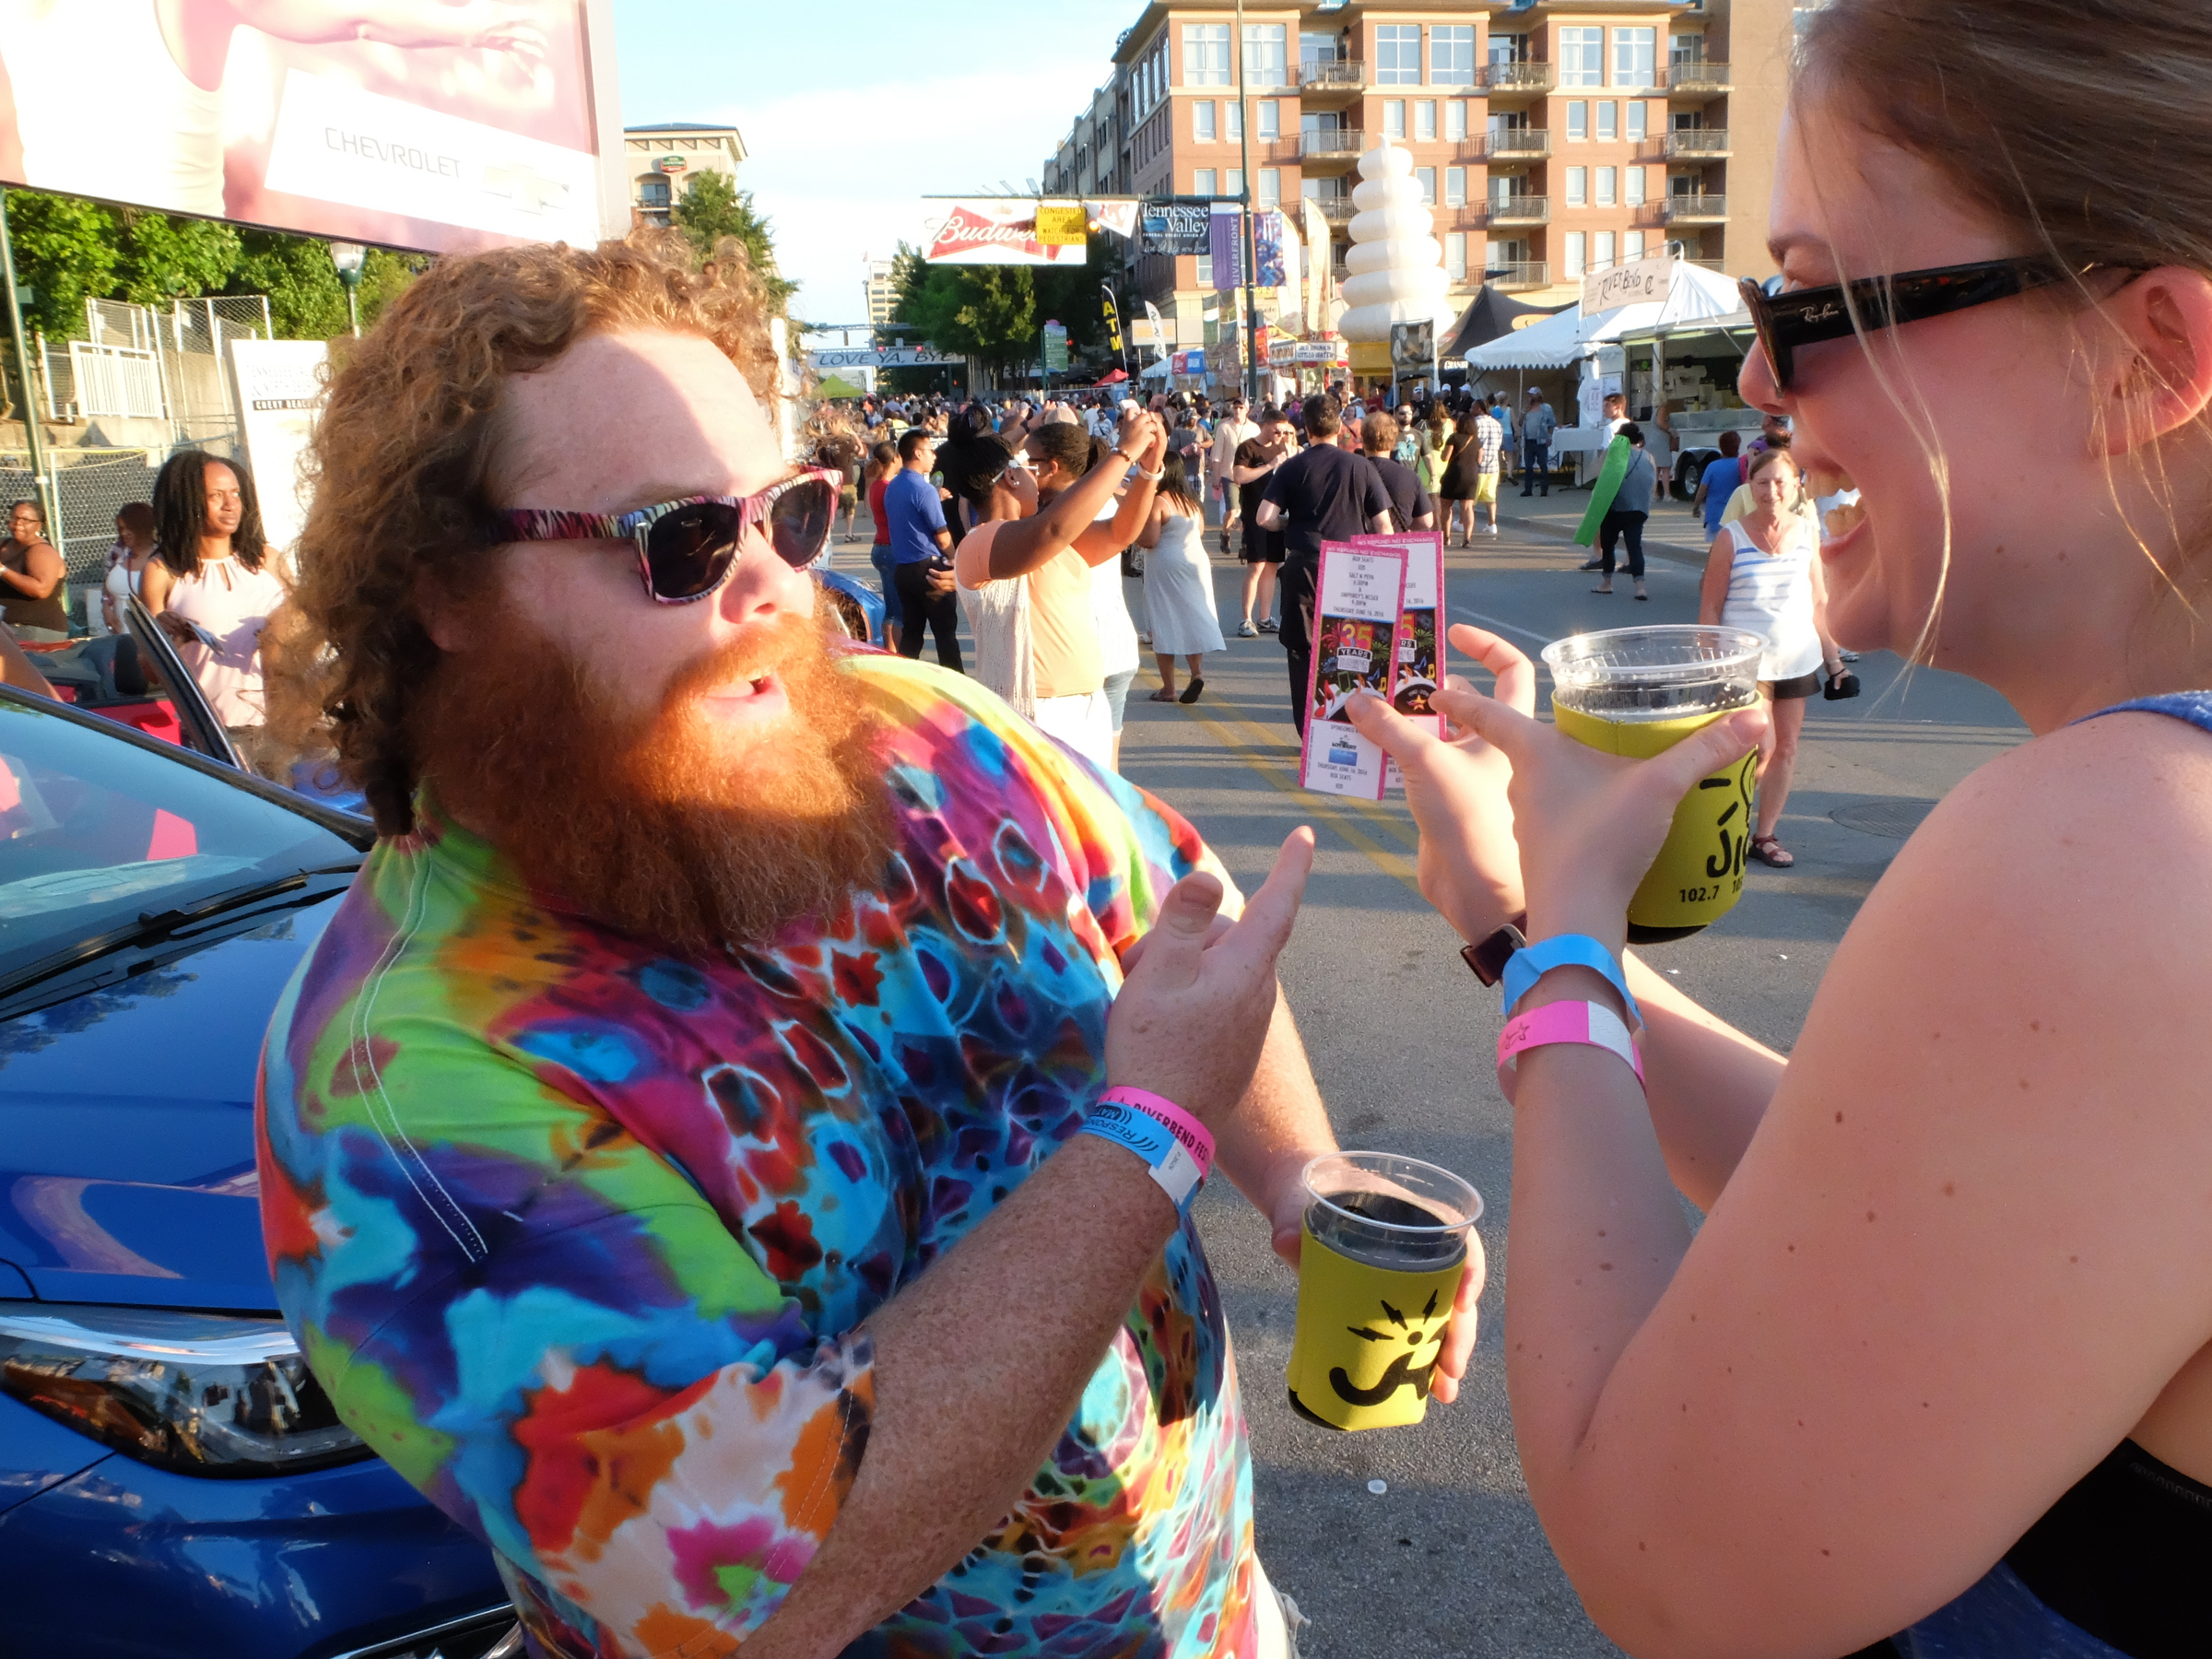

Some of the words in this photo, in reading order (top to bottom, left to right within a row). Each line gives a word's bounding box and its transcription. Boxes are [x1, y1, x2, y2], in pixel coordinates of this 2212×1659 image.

[325, 127, 461, 178] CHEVROLET
[1142, 202, 1208, 218] Tennessee
[1167, 218, 1209, 235] Valley
[1039, 235, 1084, 243] PEDESTRIANS
[1230, 217, 1240, 286] RIVERFRONT
[1102, 300, 1123, 351] ATM
[819, 353, 869, 366] LOVE
[878, 352, 905, 364] YA,
[1340, 623, 1372, 650] 35
[1341, 649, 1369, 658] YEARS
[1679, 885, 1720, 902] 102.7
